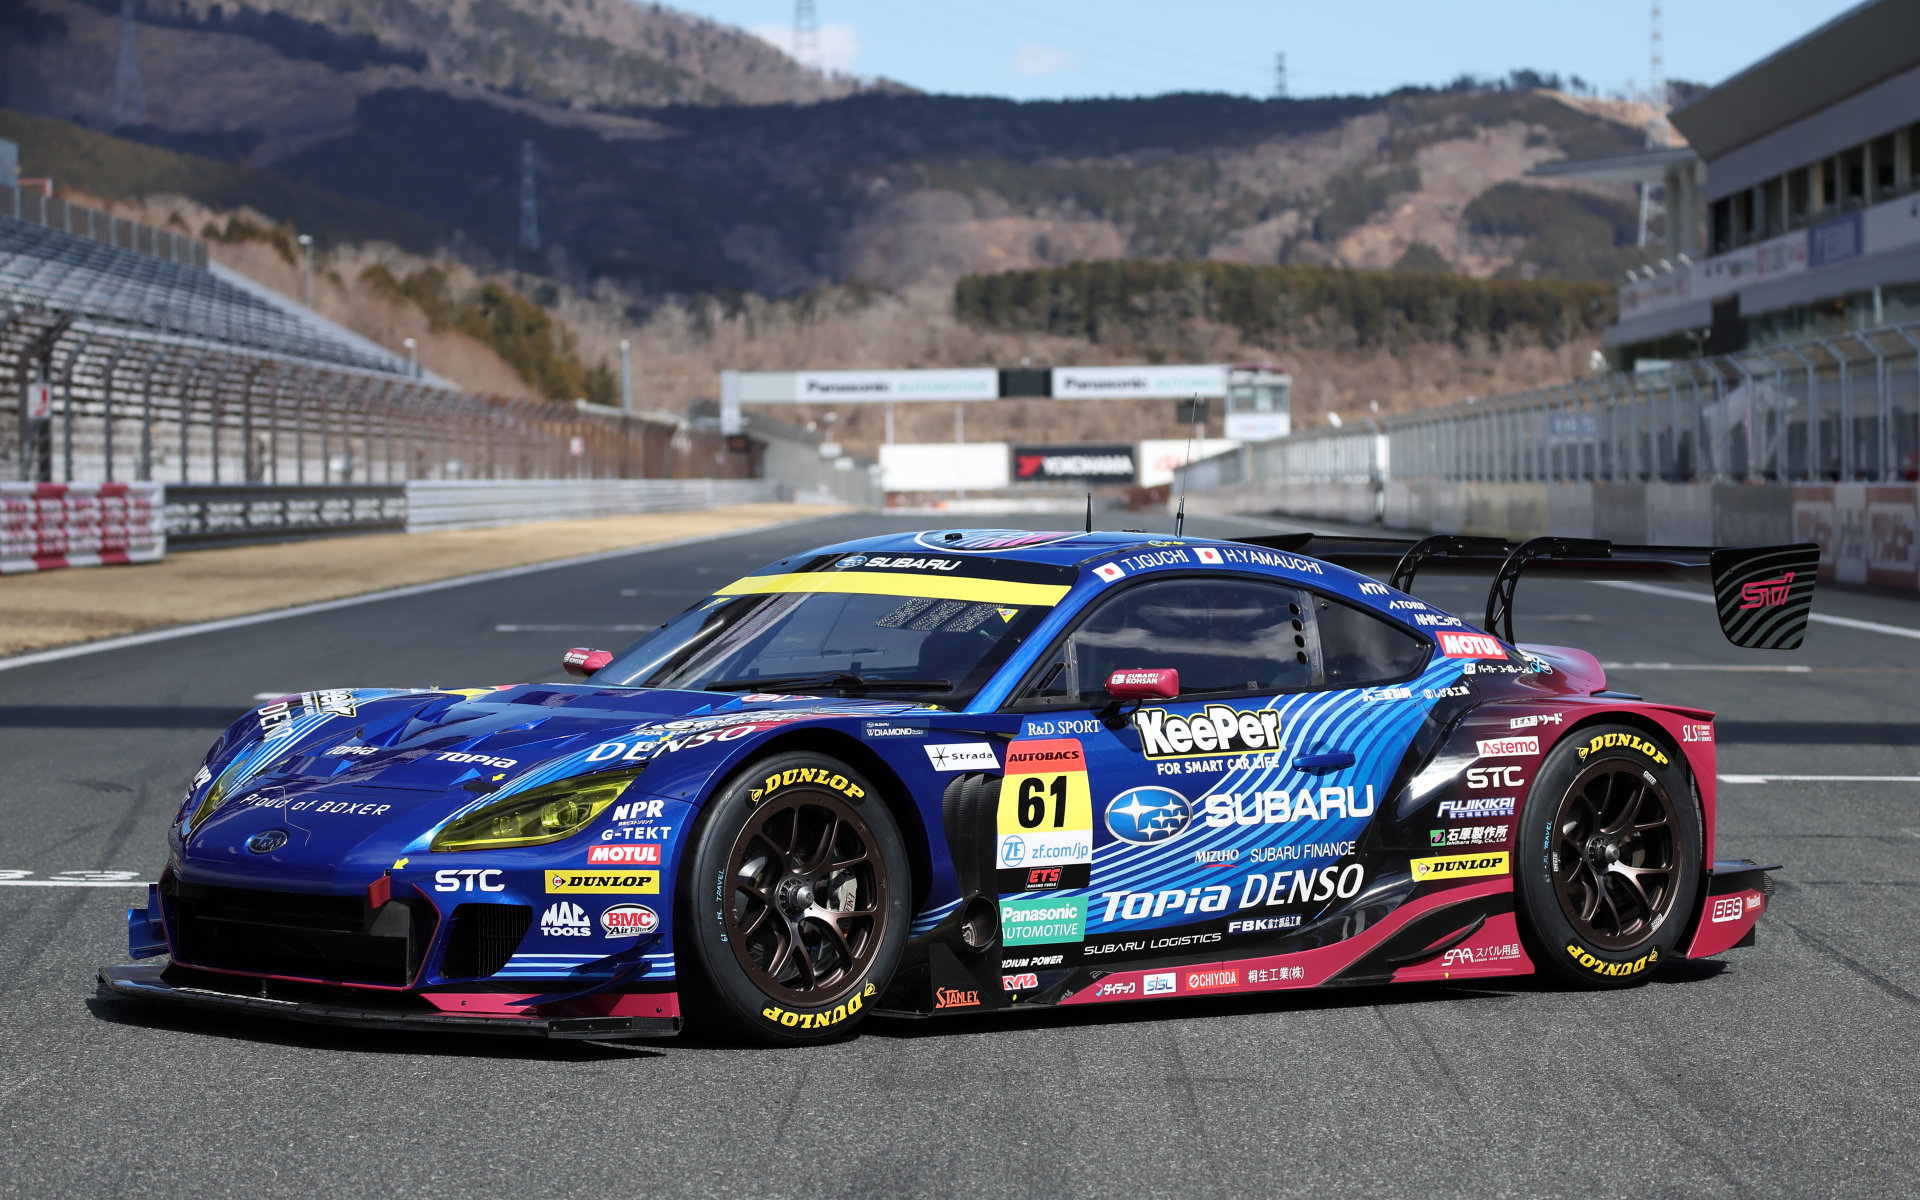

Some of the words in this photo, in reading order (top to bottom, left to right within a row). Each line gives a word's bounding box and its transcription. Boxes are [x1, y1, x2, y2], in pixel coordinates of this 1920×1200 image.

[806, 380, 890, 394] Panasonic
[1064, 378, 1149, 391] Panasonic
[1043, 454, 1134, 476] YOKOHAMA
[865, 556, 962, 571] SUBARU
[1121, 548, 1190, 571] T.IGUCHI
[1223, 548, 1324, 575] H.YAMAUCHI
[1358, 582, 1390, 596] NTN
[1443, 634, 1503, 656] MOTUL
[1028, 722, 1055, 736] R&D
[1056, 719, 1101, 735] SPORT
[1136, 706, 1280, 755] KeePer
[1682, 724, 1698, 742] SLS
[585, 725, 757, 763] DENSO
[1482, 740, 1538, 754] Astemo
[1590, 733, 1669, 766] DUNLOP
[951, 752, 994, 760] Strada
[1008, 750, 1080, 763] AUTOBACS
[1157, 763, 1182, 776] FOR
[1184, 760, 1224, 773] SMART
[1228, 758, 1250, 770] CAR
[1252, 756, 1280, 769] LIFE
[765, 768, 866, 798] DUNLOP
[1466, 766, 1525, 789] STC
[239, 793, 291, 809] Proud
[293, 800, 316, 812] of
[316, 800, 392, 816] BOXER
[612, 800, 665, 821] NPR
[1017, 775, 1068, 828] 61
[1205, 784, 1375, 828] SUBARU
[1437, 797, 1516, 818] FUJIKIKAI
[601, 826, 672, 841] G-TEKT
[1447, 825, 1508, 842] 石原製作所
[1544, 820, 1552, 850] TRAVEL
[591, 846, 658, 862] MOTUL
[1031, 842, 1088, 860] zf.com/jp
[1195, 849, 1240, 864] MIZUHO
[1250, 847, 1301, 863] SUBARU
[1304, 841, 1356, 859] FINANCE
[1432, 857, 1503, 872] DUNLOP
[434, 868, 506, 892] STC
[567, 876, 652, 887] DUNLOP
[716, 868, 725, 902] TRAVEL
[1029, 868, 1062, 883] ETS
[1238, 862, 1365, 909] DENSO
[540, 901, 591, 926] MAC
[607, 912, 652, 927] BMC
[1002, 903, 1078, 923] Panasonic
[1712, 896, 1743, 924] BBS
[540, 926, 592, 937] TOOLS
[611, 926, 630, 936] Air
[630, 926, 650, 934] Filter
[1228, 919, 1268, 934] FBK
[1084, 940, 1146, 956] SUBARU
[1150, 932, 1222, 950] LOGISTICS
[1475, 944, 1520, 958] スバル用品
[1002, 957, 1030, 969] IDIUM
[1030, 954, 1064, 966] POWER
[1566, 945, 1648, 976] DUNLOP
[1199, 972, 1238, 987] CHIYODA
[1248, 966, 1304, 984] 桐生工業(株)
[935, 987, 981, 1008] STANLEY
[1103, 982, 1136, 996] ダイテック
[762, 993, 864, 1030] DUNLOP
